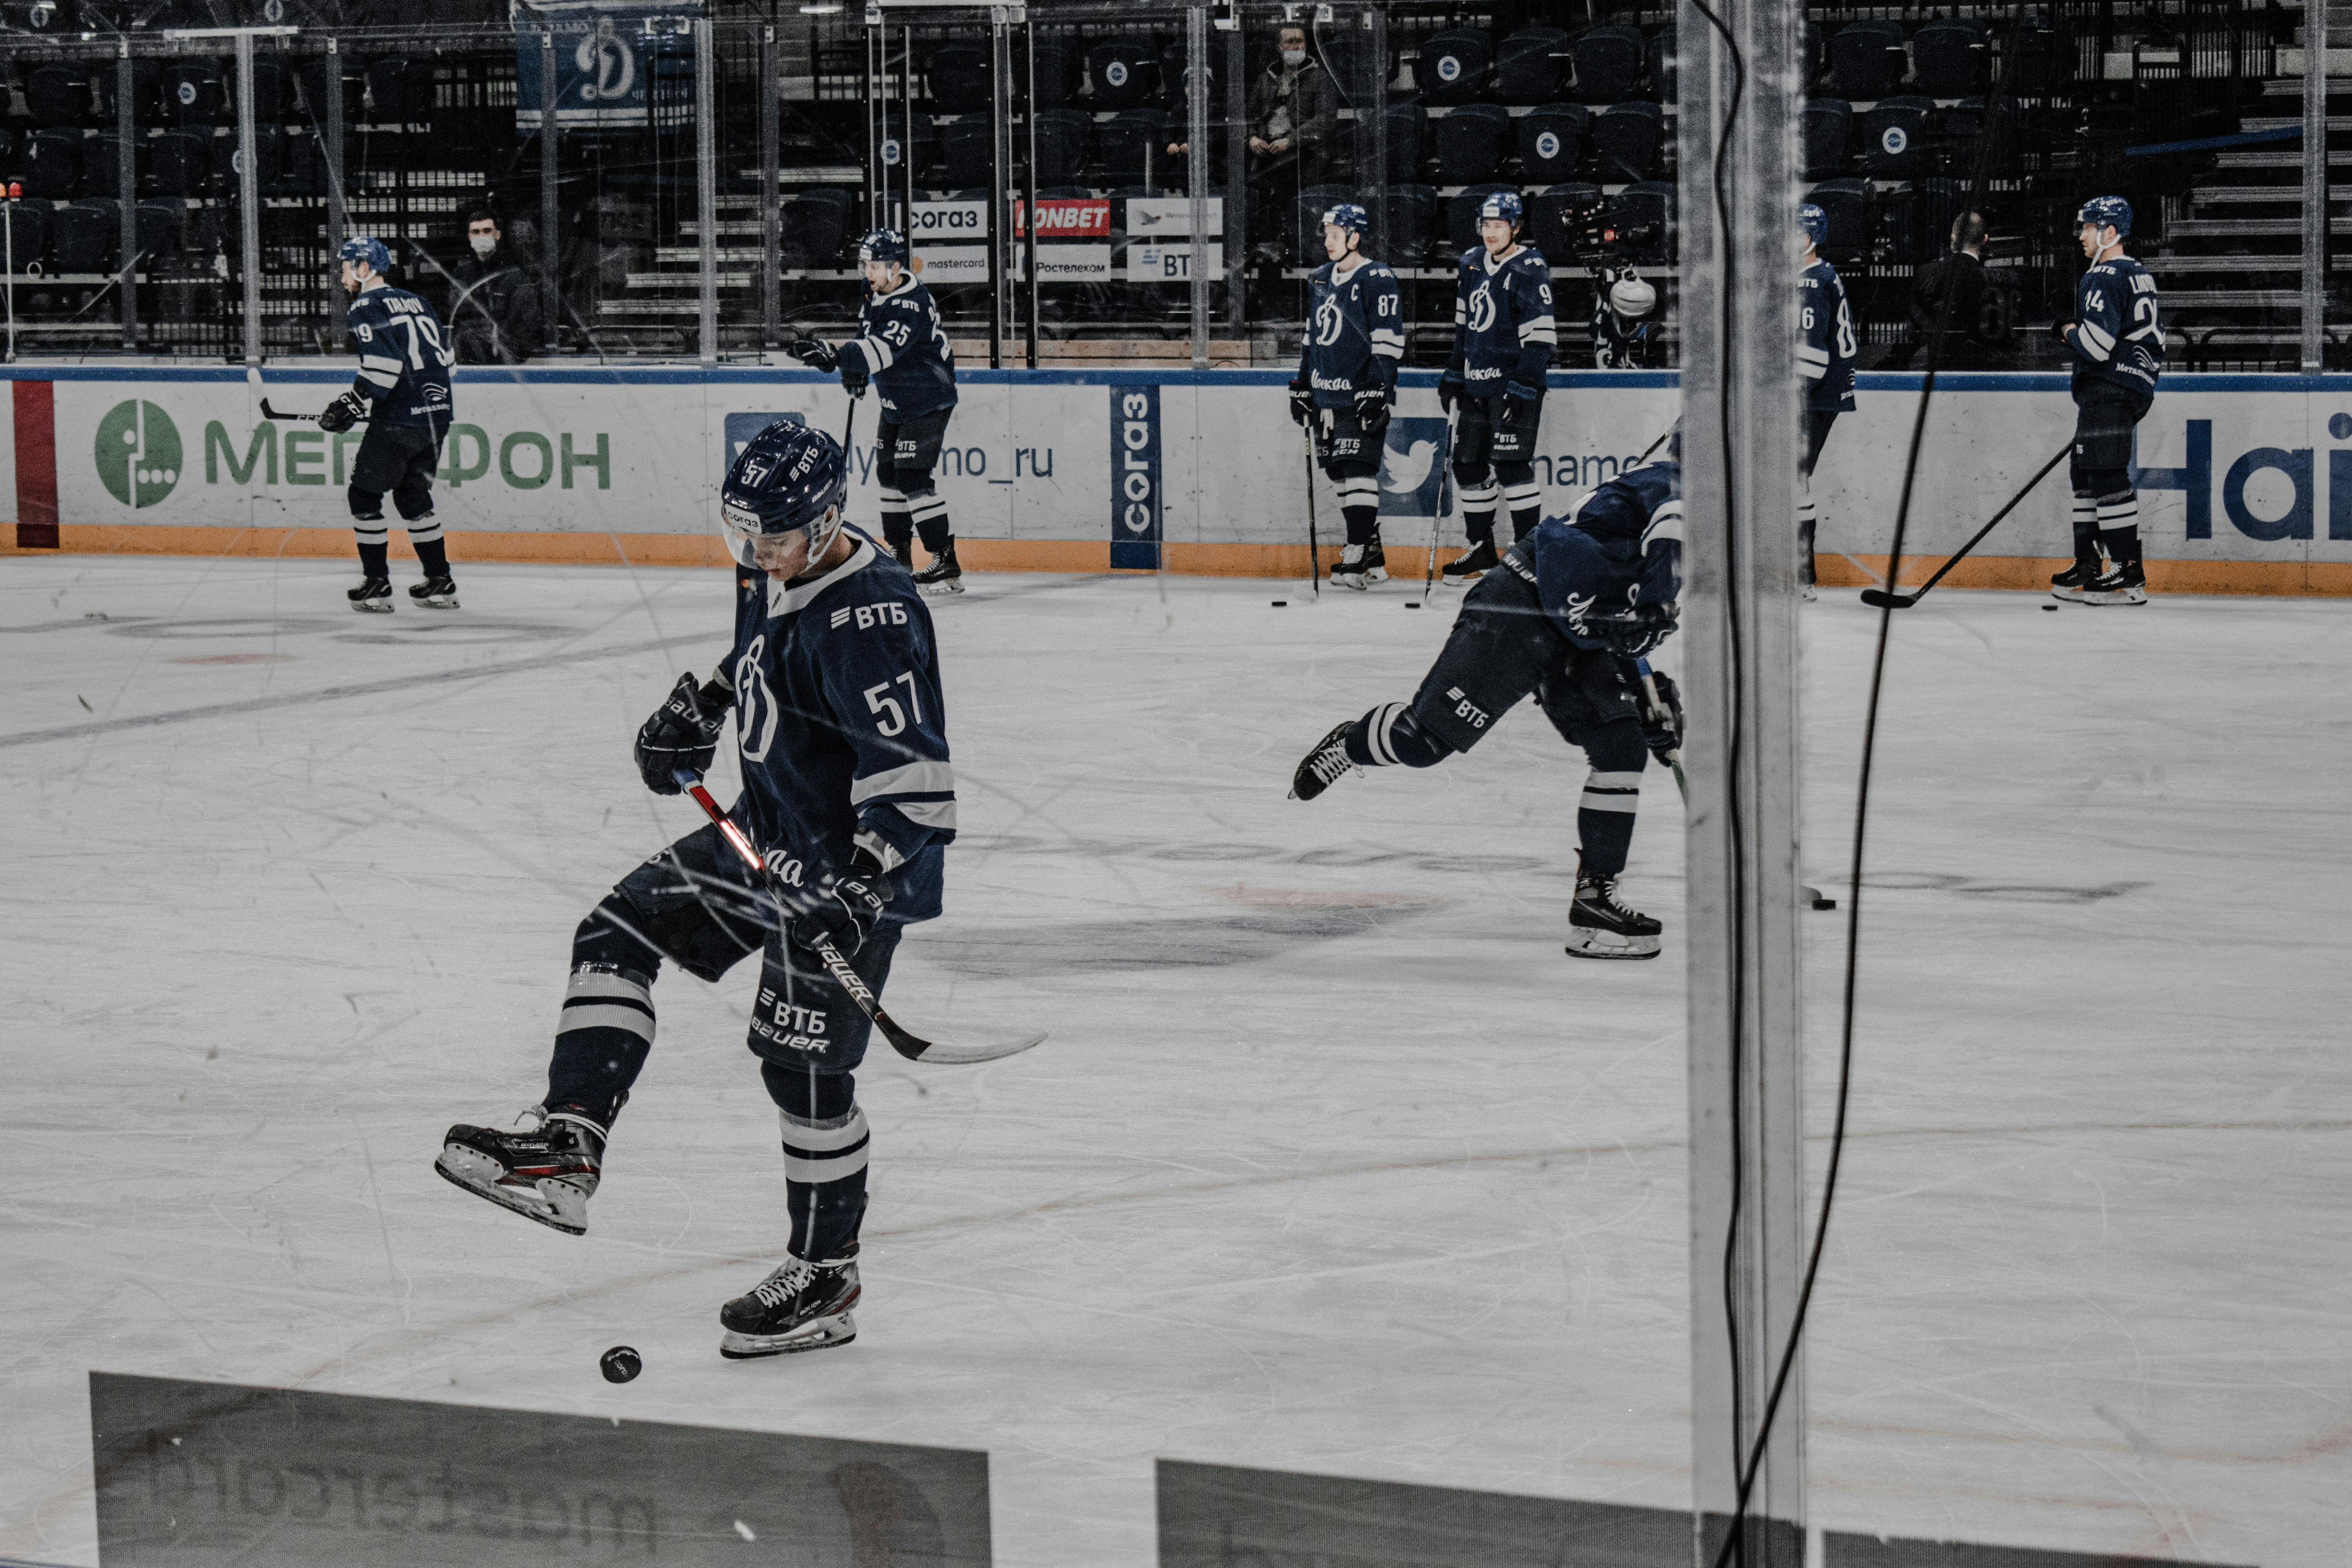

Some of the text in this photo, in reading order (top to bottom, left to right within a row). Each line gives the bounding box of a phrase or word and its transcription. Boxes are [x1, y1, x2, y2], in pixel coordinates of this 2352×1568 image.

[927, 258, 985, 269] mastercard
[1036, 262, 1105, 273] Ростелеком
[1164, 254, 1191, 277] ВТ
[901, 299, 920, 313] ВТБ
[1378, 294, 1398, 317] 87
[353, 322, 373, 343] 9
[882, 320, 911, 347] 25
[1837, 298, 1857, 359] 8
[340, 395, 364, 419] CC
[898, 440, 917, 451] ВТБ
[1340, 439, 1361, 450] ВТБ
[1500, 434, 1517, 443] ВТБ
[204, 420, 610, 490] МЕГФОН
[797, 445, 819, 475] ВТБ
[1123, 393, 1150, 532] согаз
[741, 463, 769, 488] 57
[727, 511, 759, 528] согаз
[855, 602, 908, 630] ВТБ
[863, 670, 922, 737] 57
[1454, 699, 1489, 728] ВТБ
[774, 1000, 827, 1034] ВТБ
